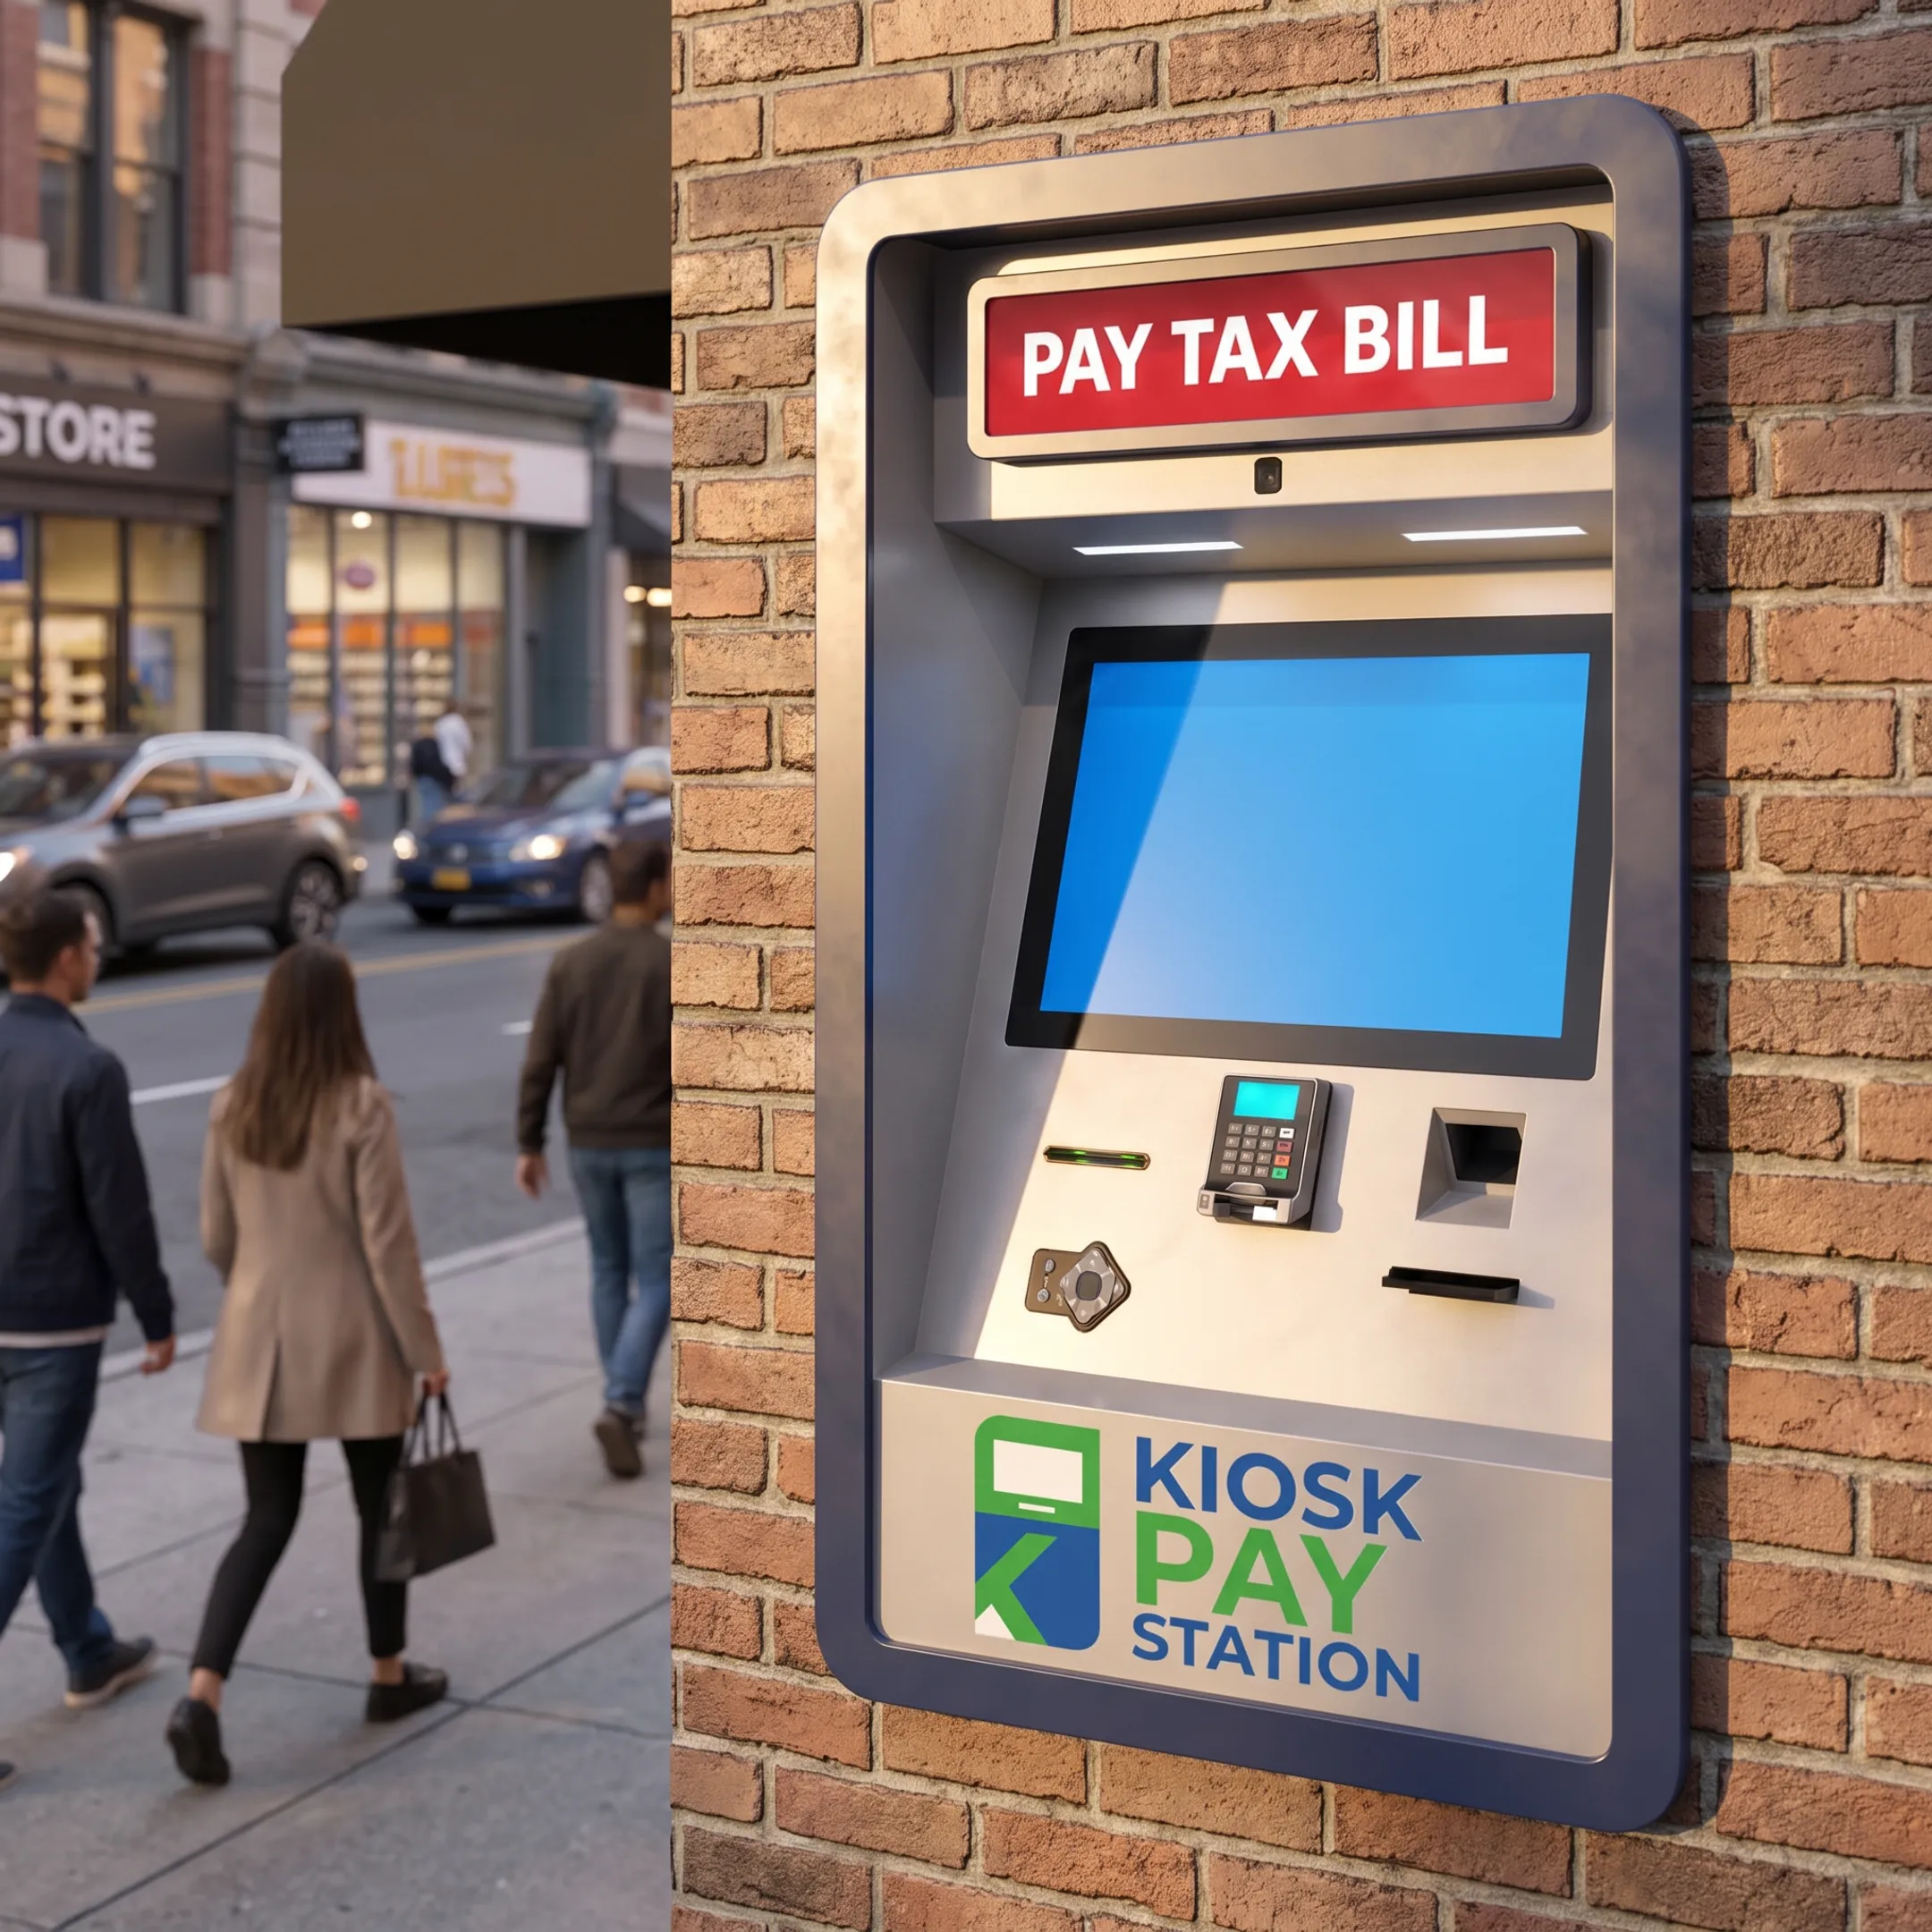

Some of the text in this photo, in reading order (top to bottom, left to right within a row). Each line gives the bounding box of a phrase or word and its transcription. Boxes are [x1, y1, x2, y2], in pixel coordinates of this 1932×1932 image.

[1022, 294, 1510, 398] PAY TAX BILL
[0, 392, 157, 470] STORE
[1135, 1436, 1424, 1542] KIOSK
[1135, 1510, 1388, 1635] PAY
[1131, 1612, 1420, 1702] STATION
